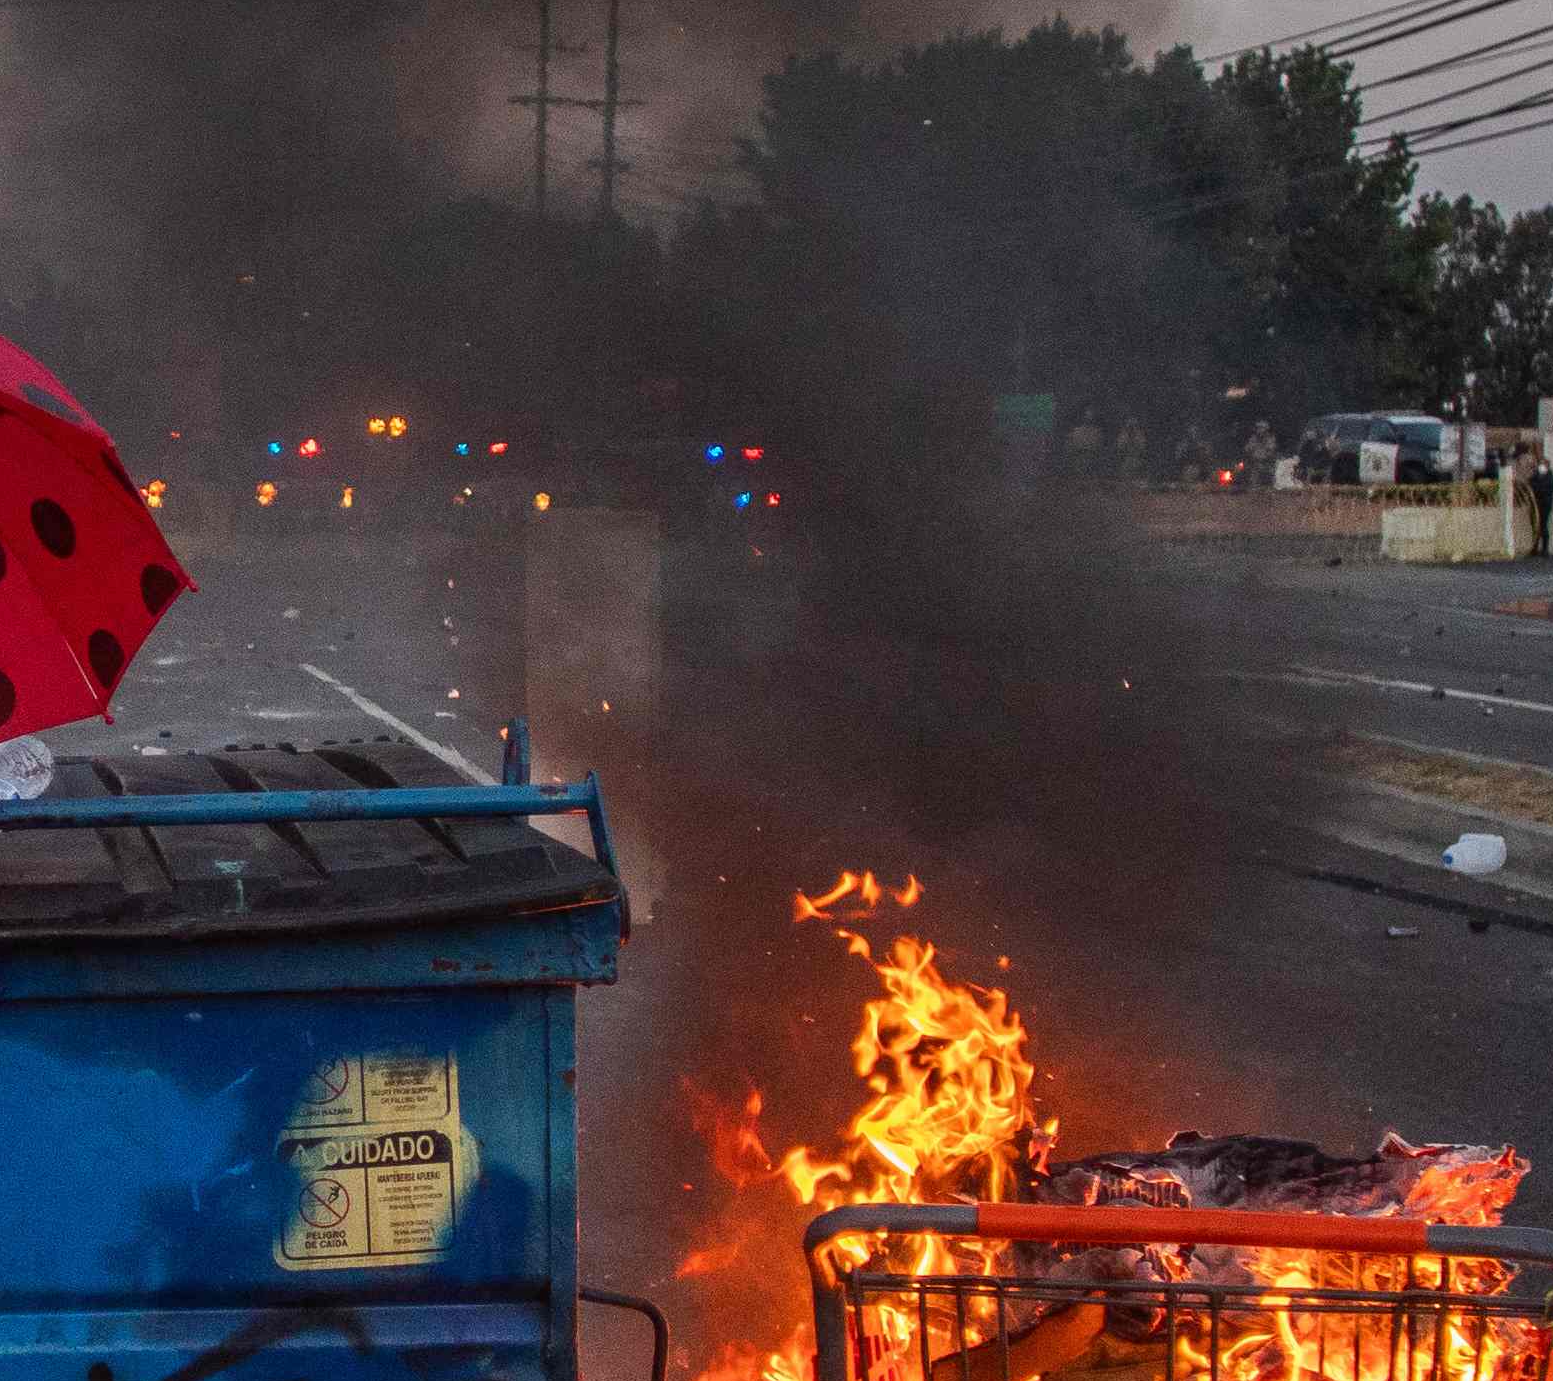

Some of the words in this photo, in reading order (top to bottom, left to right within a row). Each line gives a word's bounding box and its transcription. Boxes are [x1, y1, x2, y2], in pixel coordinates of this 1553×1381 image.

[322, 1134, 435, 1166] CUIDADO
[305, 1230, 347, 1240] PELIGRO
[304, 1240, 318, 1249] DE
